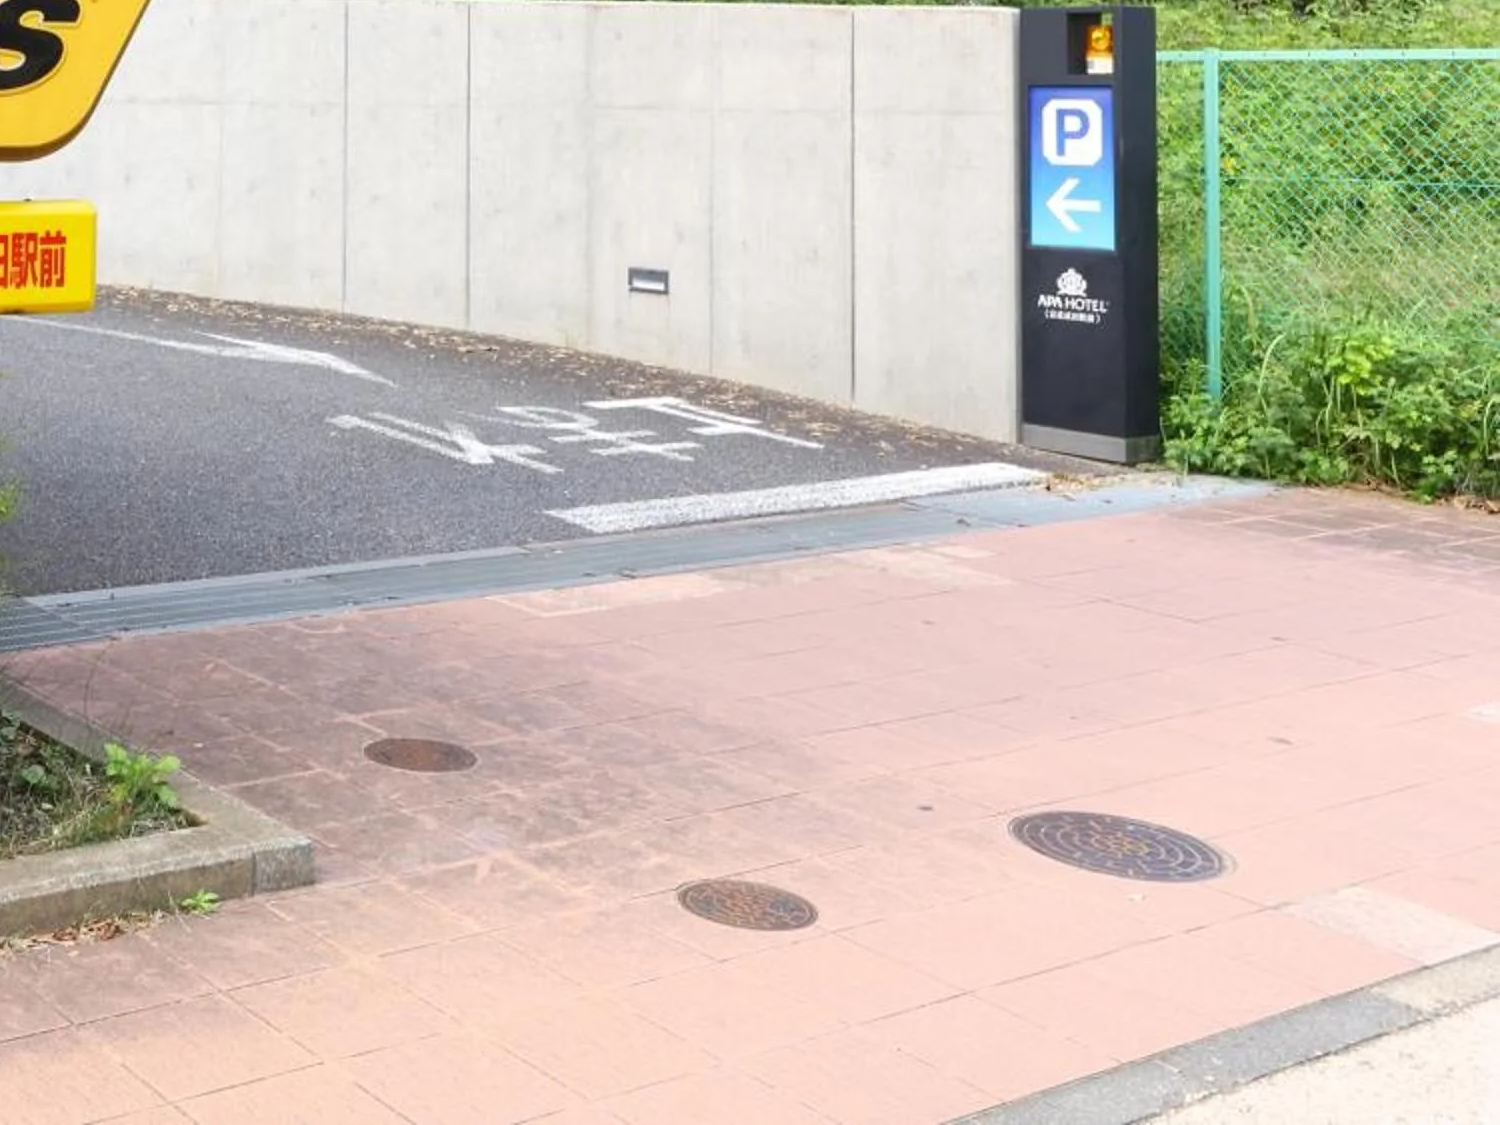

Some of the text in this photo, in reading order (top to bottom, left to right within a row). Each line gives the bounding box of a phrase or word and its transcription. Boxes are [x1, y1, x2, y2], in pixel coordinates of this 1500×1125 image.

[1055, 107, 1090, 157] P
[1037, 294, 1108, 314] APA HOTEL
